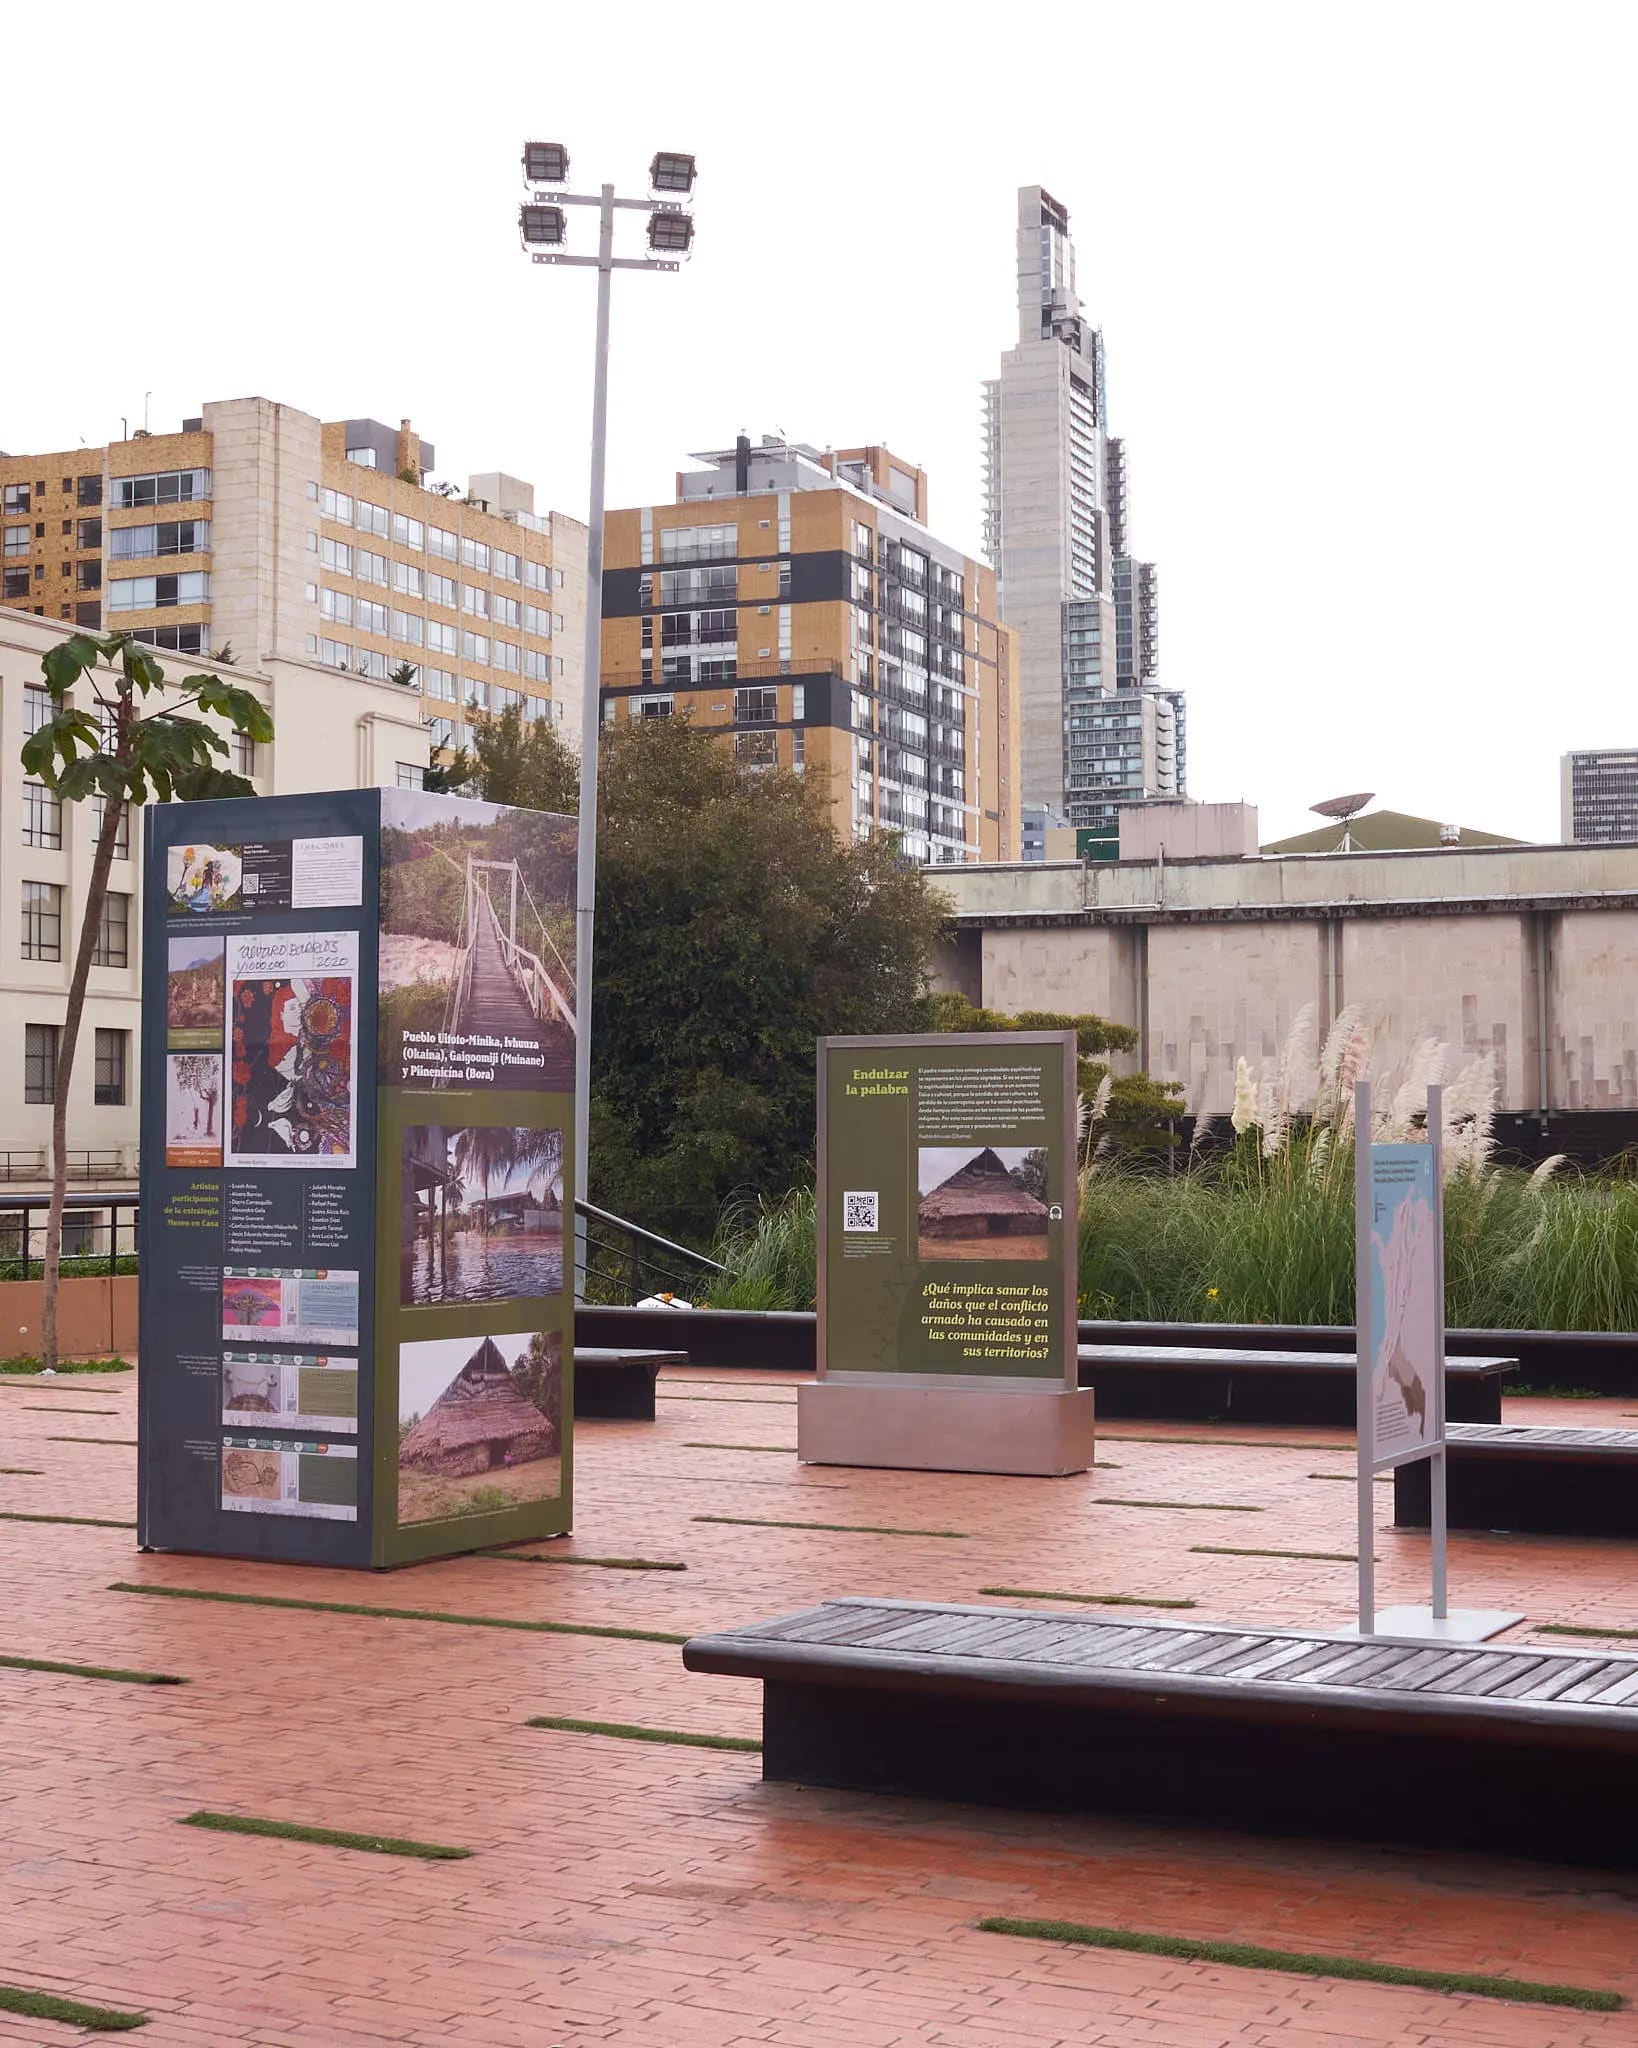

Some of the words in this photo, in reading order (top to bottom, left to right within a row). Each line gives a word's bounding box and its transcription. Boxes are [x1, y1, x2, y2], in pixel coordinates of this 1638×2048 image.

[402, 1030, 436, 1044] Pueblo
[504, 1036, 540, 1050] Ivhuuza
[402, 1046, 448, 1062] (Okaina),
[500, 1053, 545, 1068] (Muinane)
[402, 1066, 409, 1079] y
[465, 1066, 495, 1082] (Bora)
[853, 1068, 909, 1080] Endulzar
[846, 1083, 858, 1095] la
[860, 1083, 909, 1098] palabra
[191, 1182, 219, 1191] Artistas
[172, 1195, 219, 1204] participantes
[164, 1206, 174, 1214] de
[174, 1206, 182, 1214] la
[183, 1207, 219, 1216] estrategia
[168, 1219, 190, 1227] Museo
[201, 1219, 219, 1227] Casa
[922, 1282, 951, 1296] ¿Qué
[953, 1283, 994, 1297] implica
[996, 1286, 1030, 1296] sanar
[1032, 1285, 1049, 1296] los
[929, 1298, 963, 1310] daños
[965, 1301, 986, 1313] que
[988, 1299, 999, 1311] el
[1000, 1300, 1049, 1314] conflicto
[921, 1314, 965, 1325] armado
[968, 1314, 982, 1326] ha
[985, 1316, 1032, 1327] causado
[1034, 1318, 1049, 1328] en
[929, 1329, 946, 1341] las
[948, 1330, 1022, 1343] comunidades
[1024, 1333, 1032, 1345] y
[1034, 1335, 1049, 1343] en
[963, 1347, 983, 1357] sus
[984, 1346, 1050, 1359] territorios?
